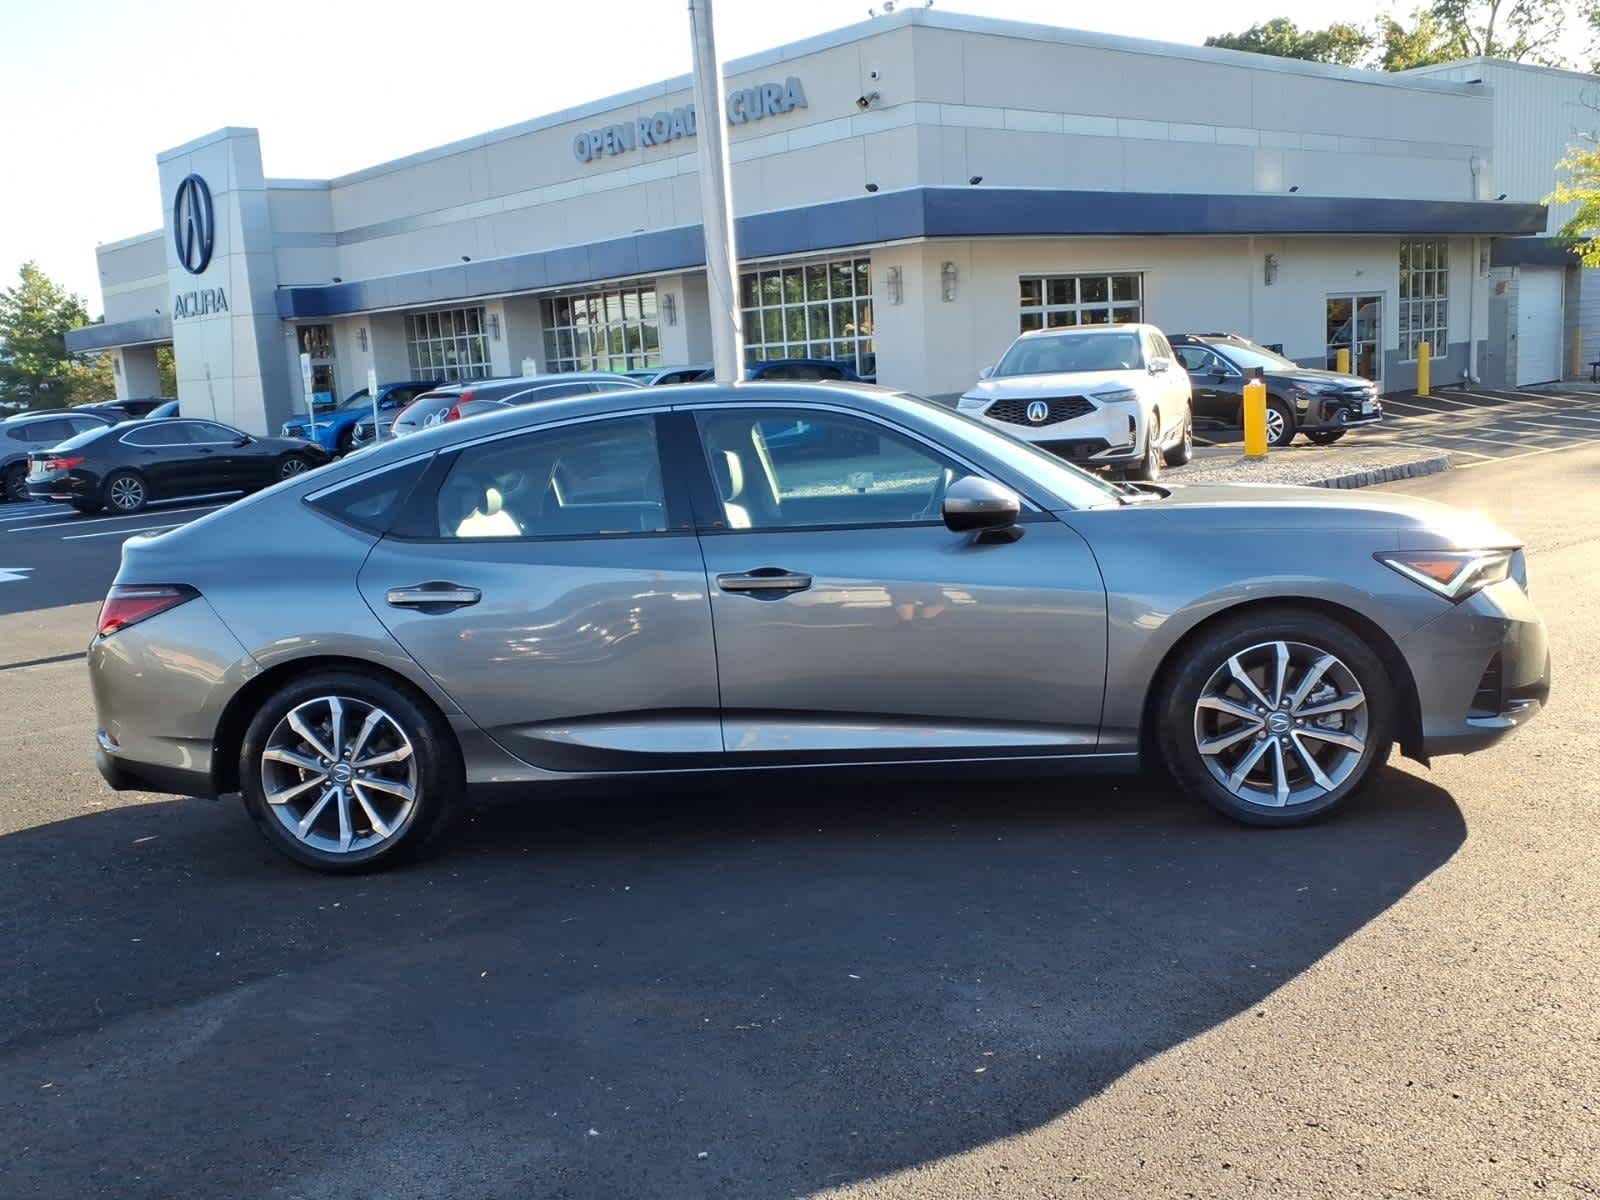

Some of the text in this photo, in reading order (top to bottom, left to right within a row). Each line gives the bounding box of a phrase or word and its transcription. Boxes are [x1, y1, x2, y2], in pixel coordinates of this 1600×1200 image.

[573, 122, 635, 163] OPEN
[726, 76, 808, 126] CURA
[174, 287, 229, 320] ACURA
